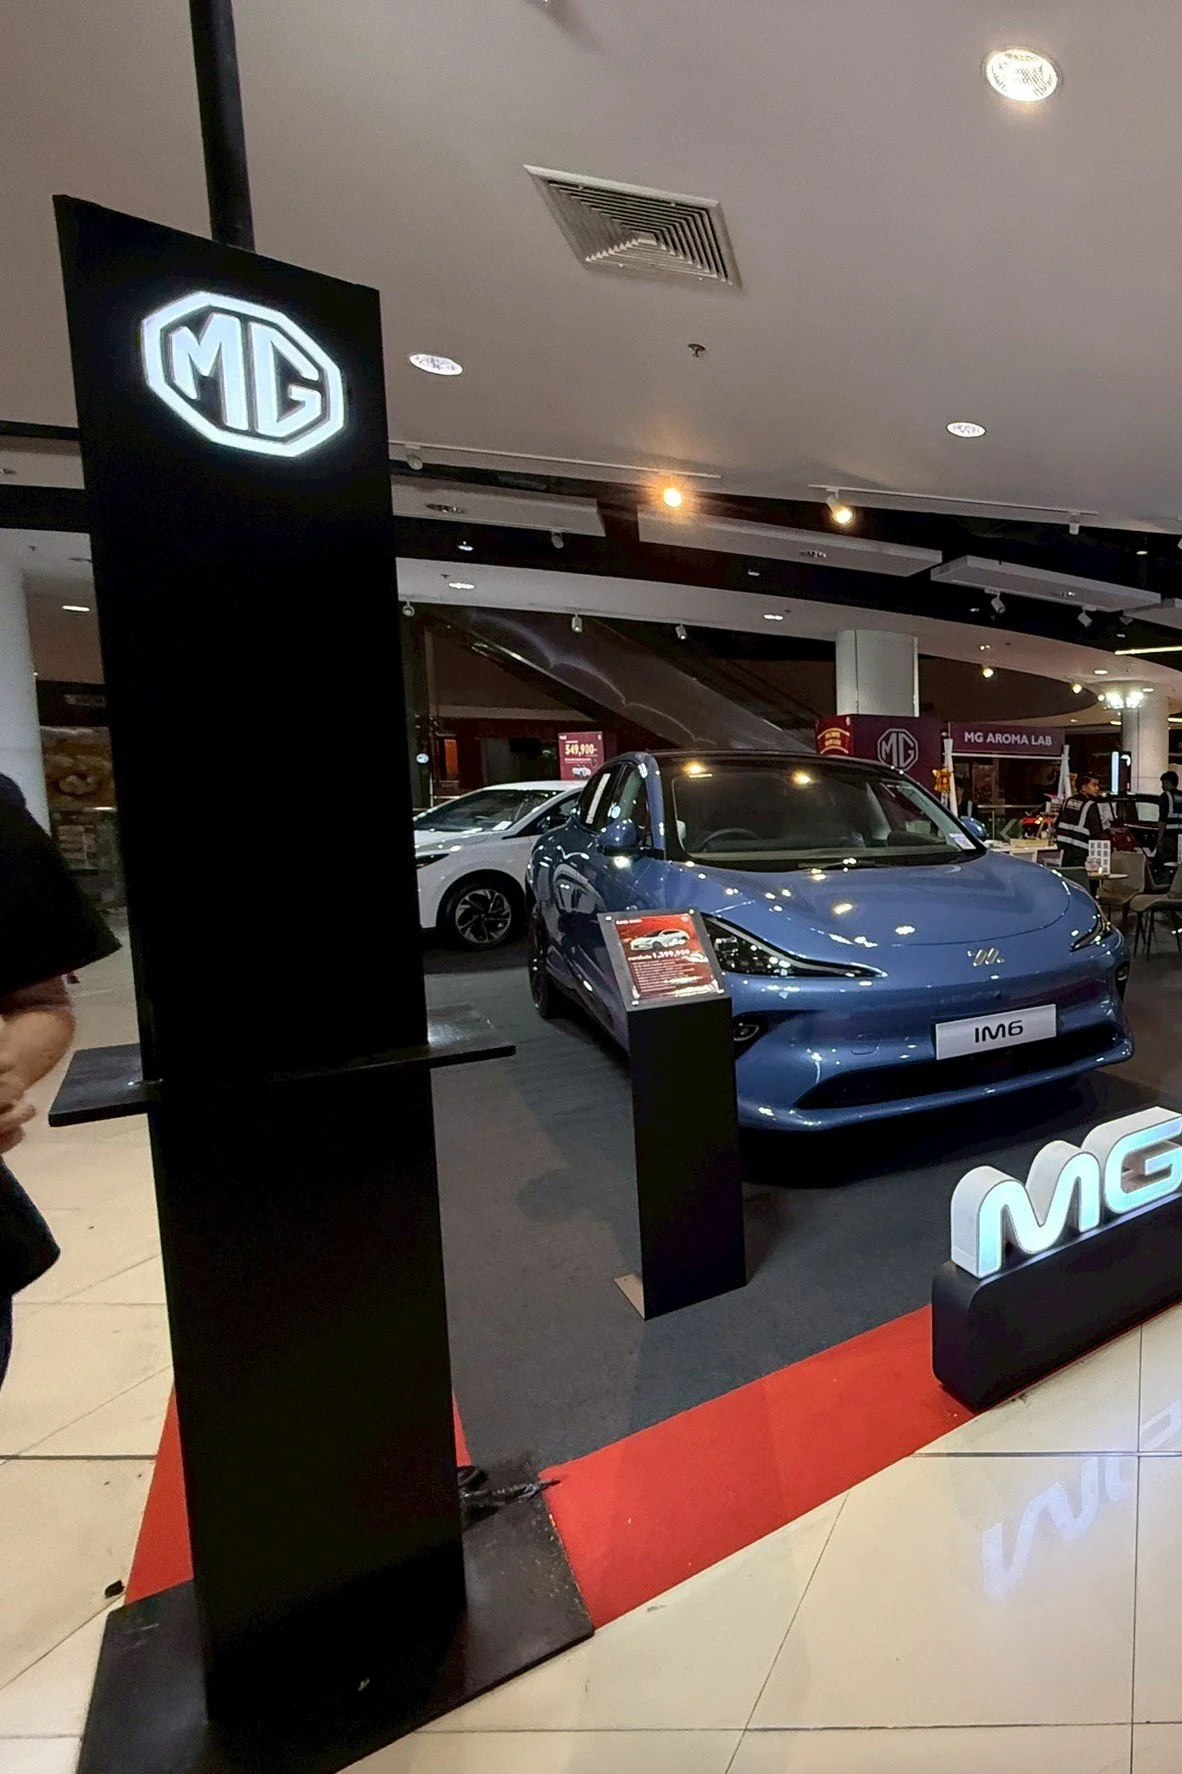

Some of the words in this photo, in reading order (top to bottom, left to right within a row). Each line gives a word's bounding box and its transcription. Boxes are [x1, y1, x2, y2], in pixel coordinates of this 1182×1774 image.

[170, 312, 322, 438] MG
[881, 731, 915, 769] MG
[964, 731, 984, 743] MG
[986, 732, 1029, 746] AROMA
[1031, 735, 1053, 746] LAB
[975, 1020, 1024, 1043] IM6
